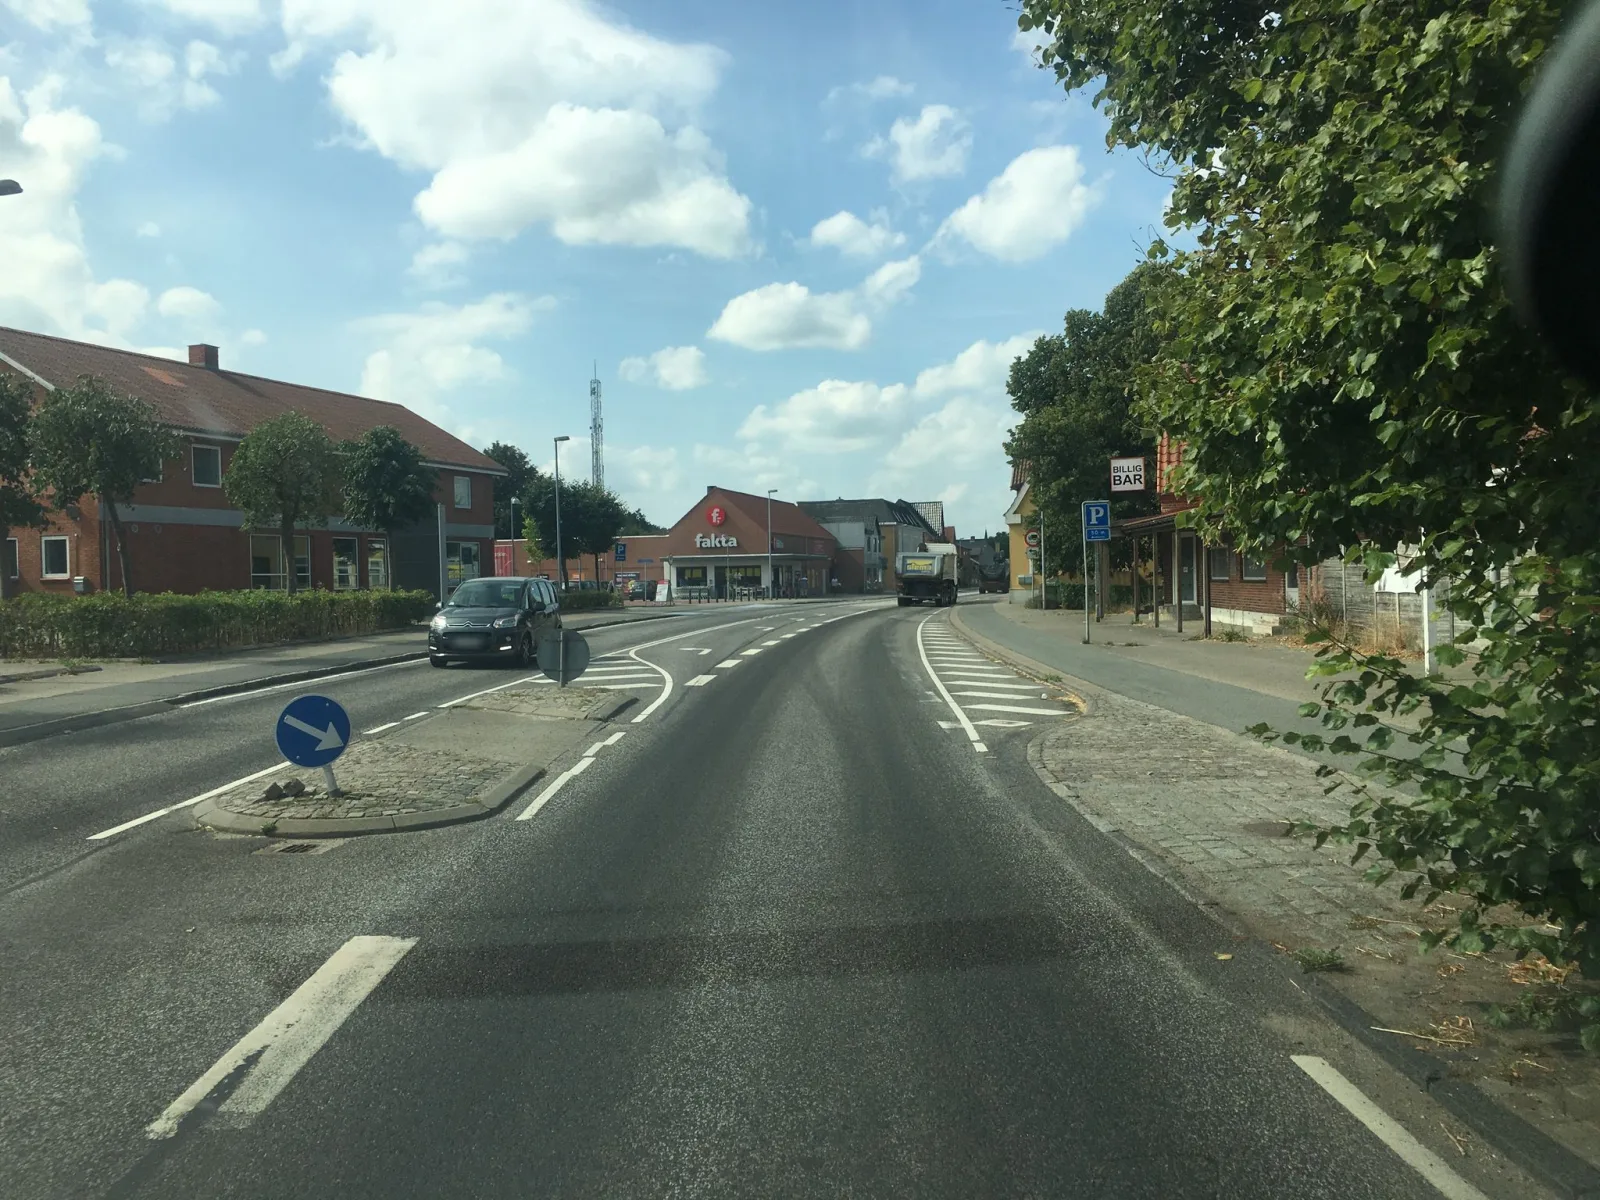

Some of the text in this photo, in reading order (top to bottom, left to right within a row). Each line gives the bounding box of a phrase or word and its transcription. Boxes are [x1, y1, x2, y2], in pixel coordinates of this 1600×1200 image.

[1112, 465, 1142, 474] BILLIG
[1112, 474, 1143, 486] BAR
[1089, 506, 1104, 524] P
[695, 533, 738, 548] fakta
[618, 546, 624, 554] P
